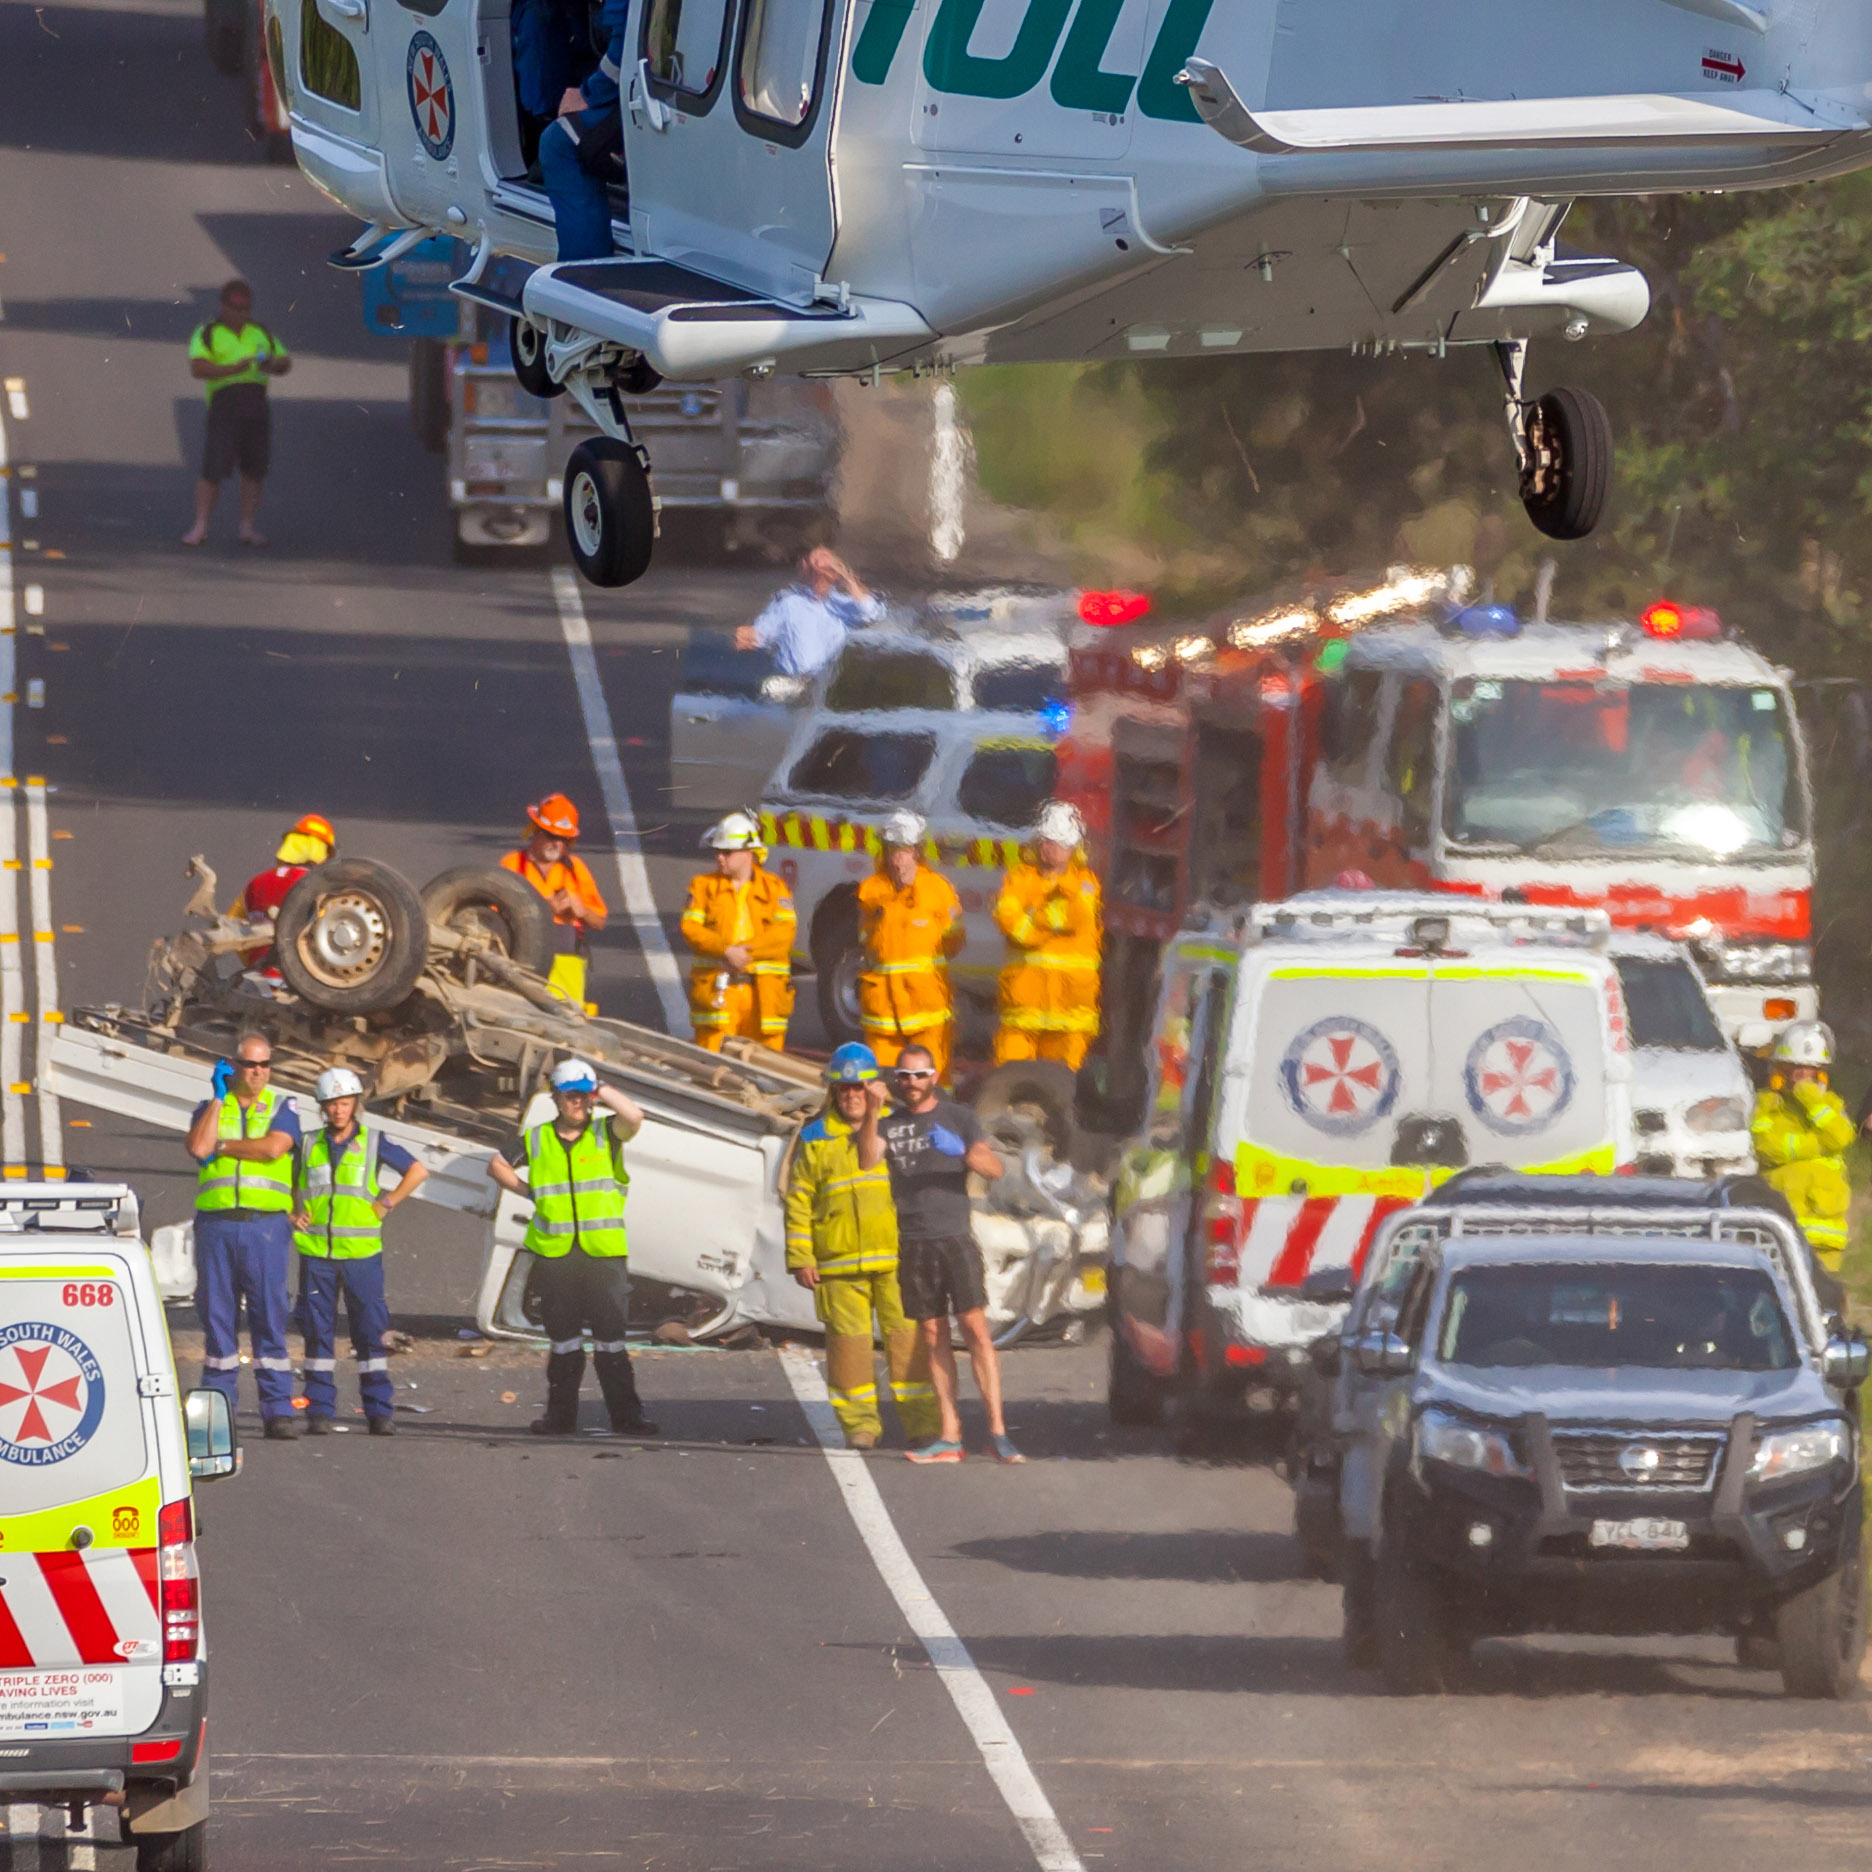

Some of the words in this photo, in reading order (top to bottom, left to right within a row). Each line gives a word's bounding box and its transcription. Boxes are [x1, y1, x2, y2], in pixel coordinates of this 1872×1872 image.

[888, 1123, 915, 1139] GET
[62, 1283, 113, 1308] 668
[57, 1330, 100, 1382] WALES
[112, 1517, 139, 1532] 000
[44, 1674, 79, 1685] ZERO
[83, 1673, 113, 1685] (000)
[41, 1685, 78, 1697] LIVES
[10, 1699, 71, 1709] information
[73, 1698, 94, 1707] visit
